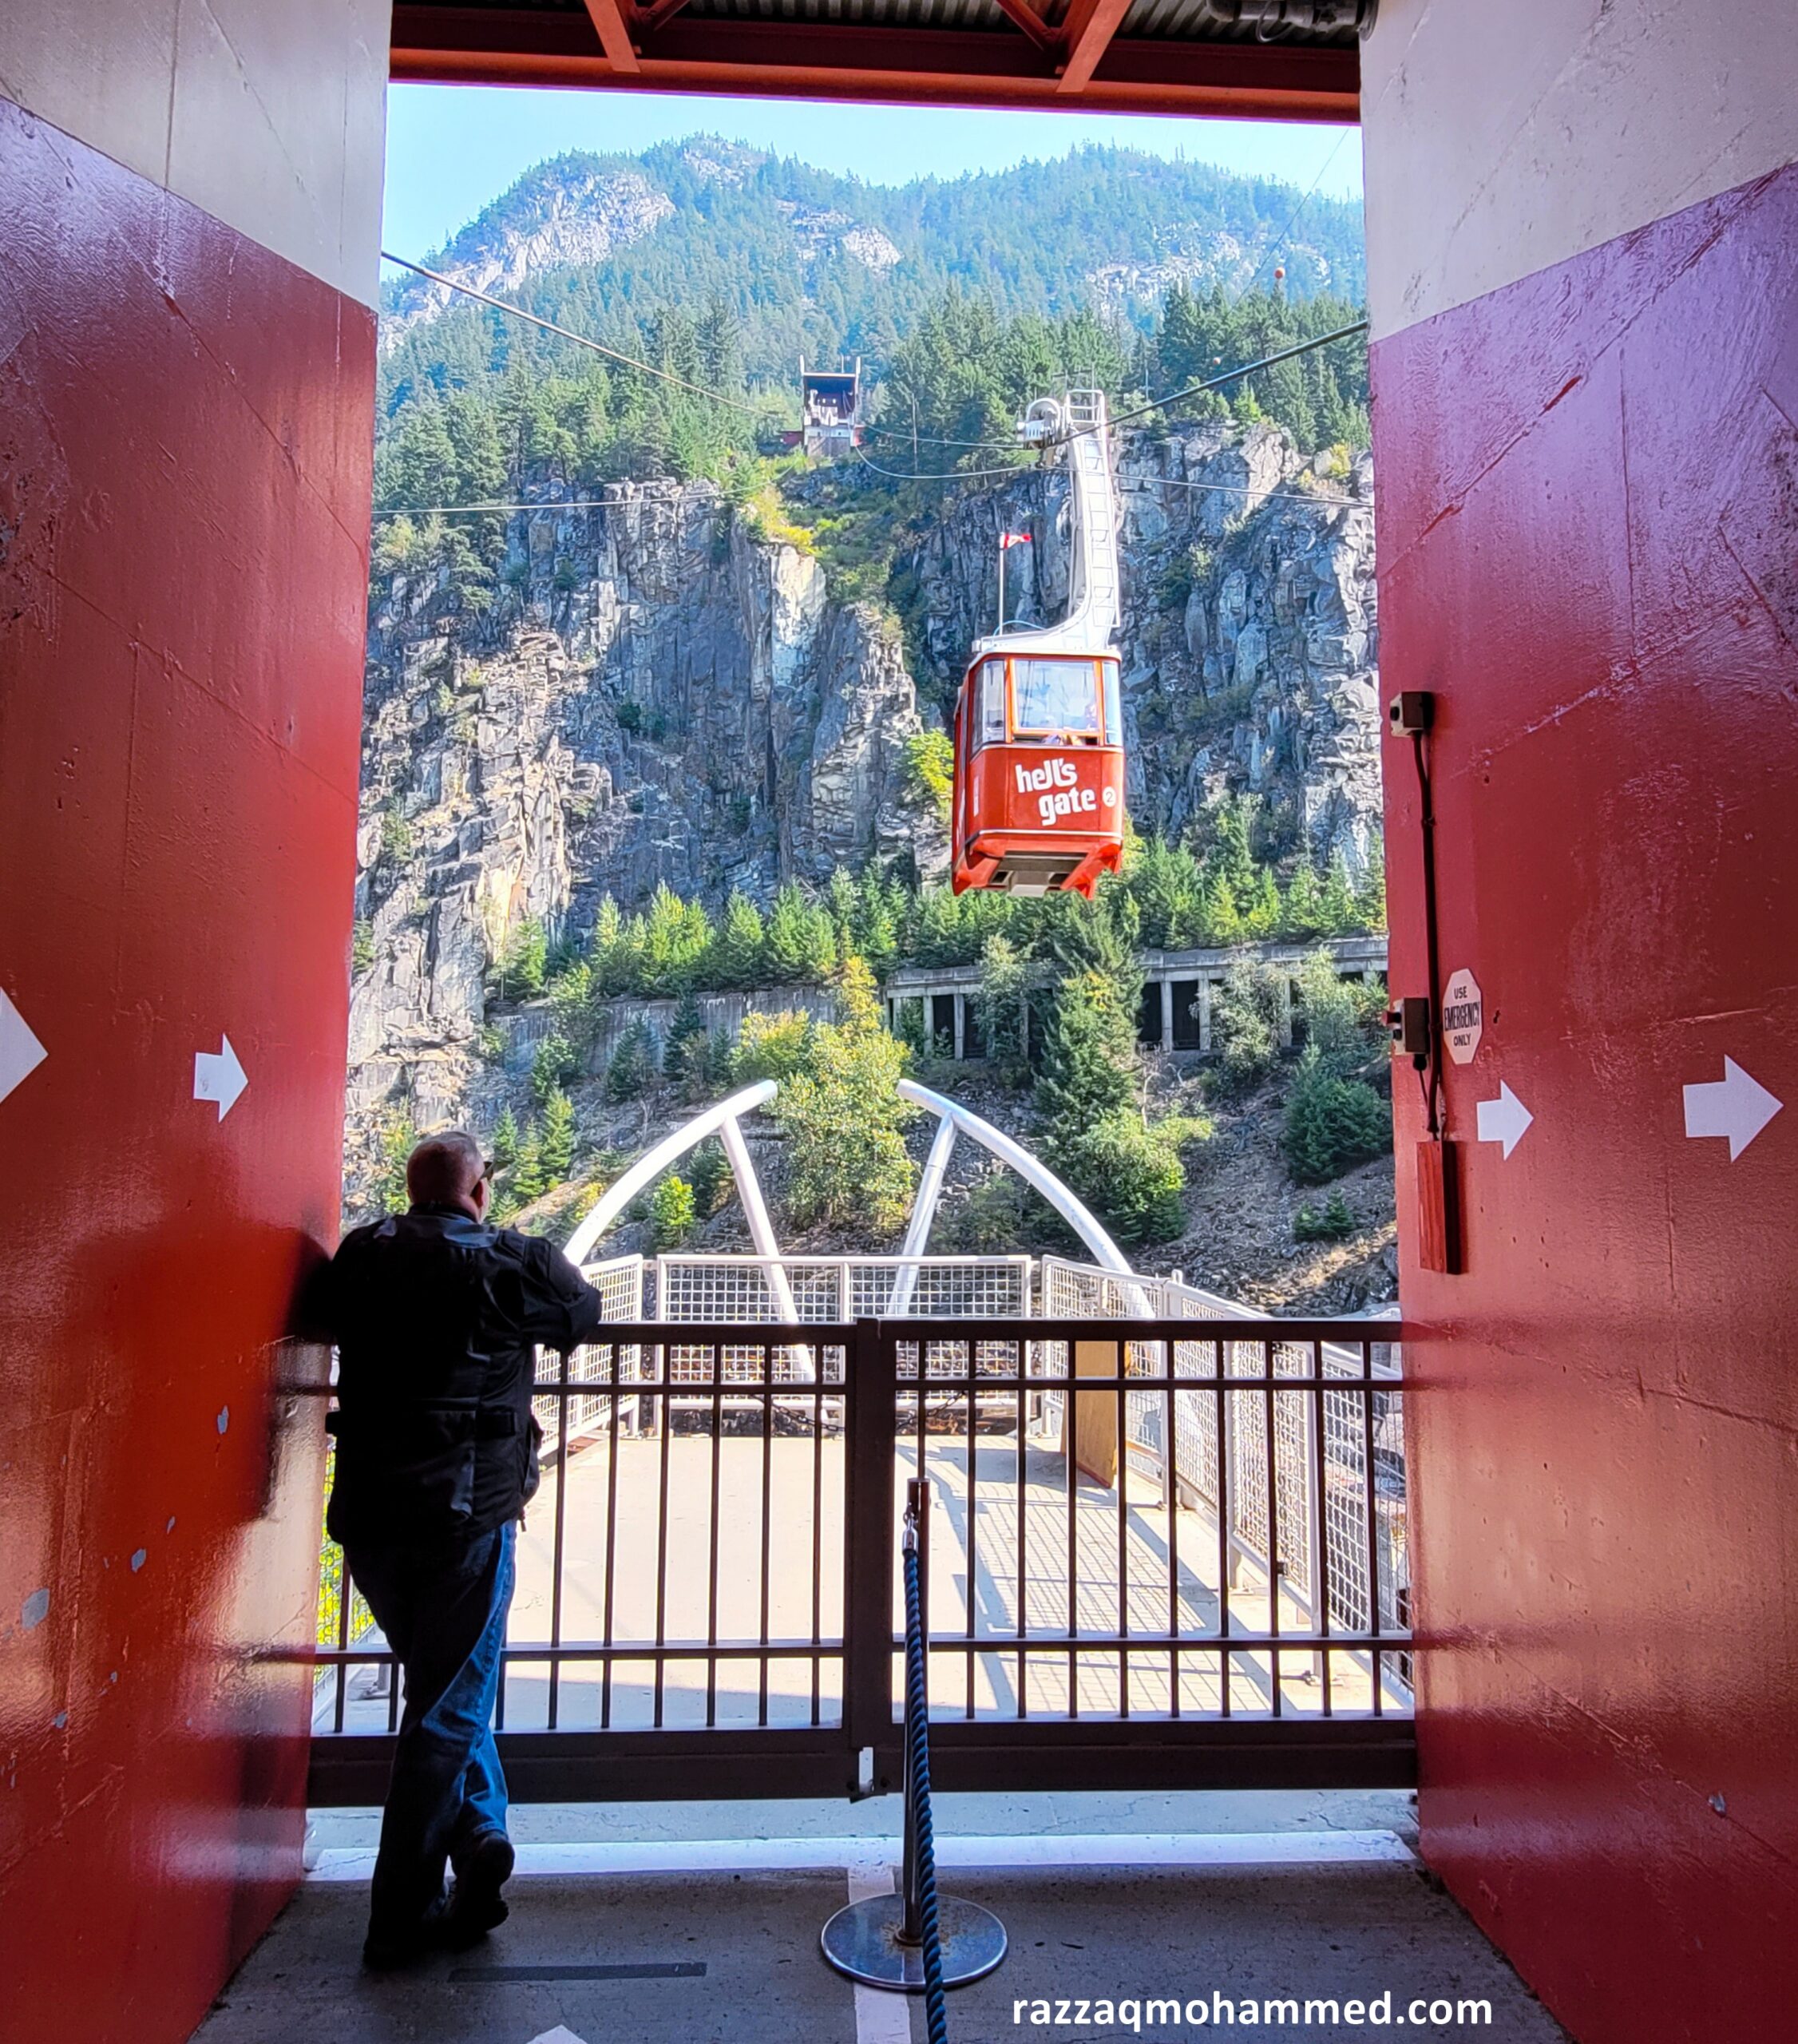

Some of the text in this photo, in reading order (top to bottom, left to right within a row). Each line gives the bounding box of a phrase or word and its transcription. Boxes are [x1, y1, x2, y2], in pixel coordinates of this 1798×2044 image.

[1015, 759, 1077, 793] hell's
[1038, 787, 1096, 826] gate
[1454, 986, 1467, 999] USE
[1444, 1001, 1480, 1031] EMERGENCY
[1453, 1033, 1471, 1047] ONLY
